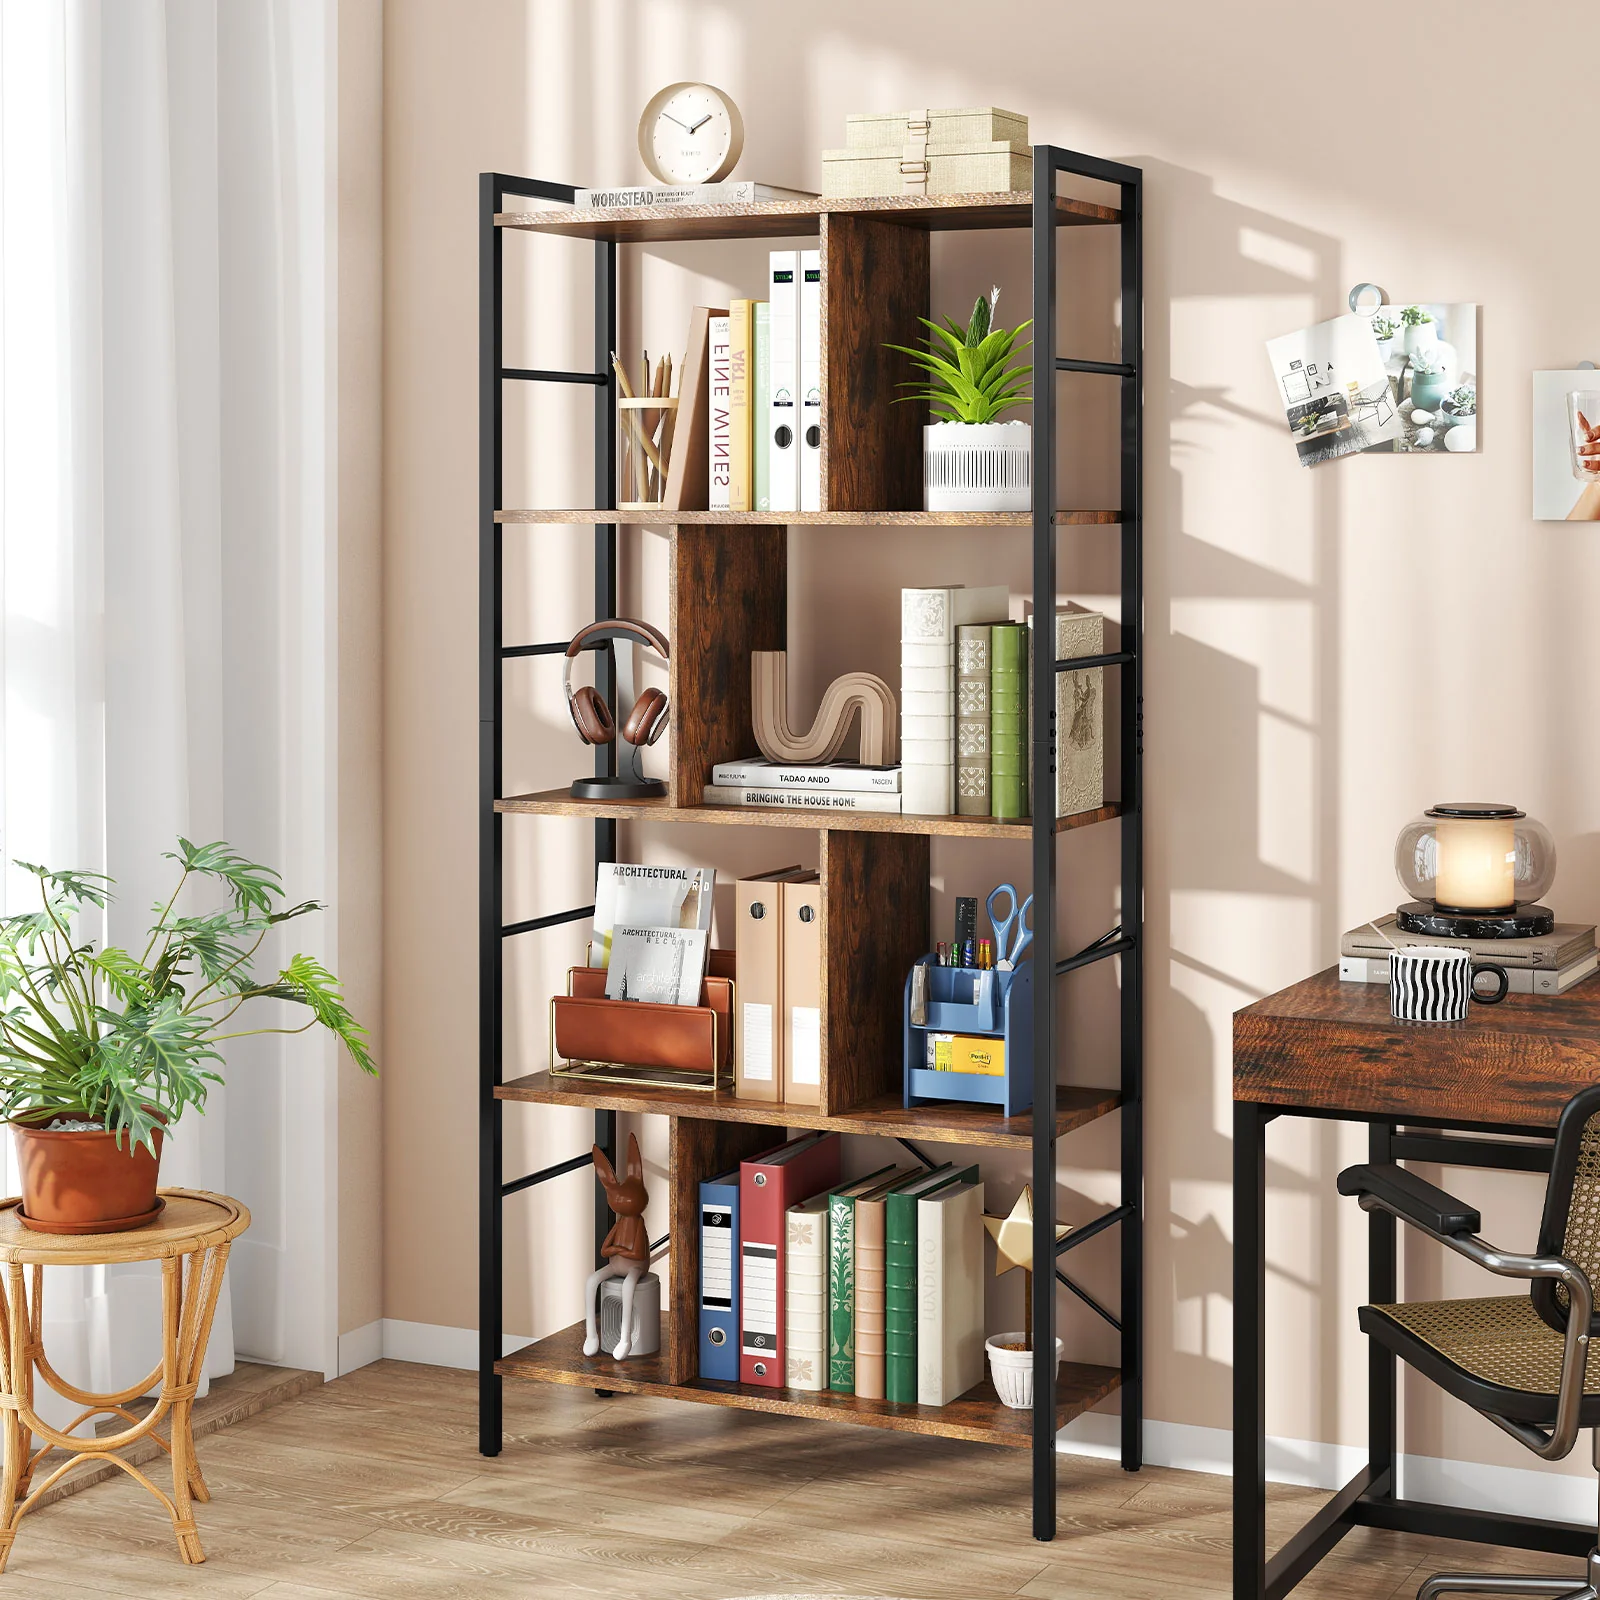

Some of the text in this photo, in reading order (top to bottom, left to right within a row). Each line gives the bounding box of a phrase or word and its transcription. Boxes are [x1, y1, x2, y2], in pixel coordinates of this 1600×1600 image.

[590, 191, 654, 208] WORKSTEAD
[779, 774, 830, 784] TADAO ANDO
[746, 792, 856, 807] BRINGING THE HOUSE HOME
[612, 866, 688, 880] ARCHITECTURAL
[647, 879, 710, 892] REORD
[621, 928, 677, 939] ARCHITECTURAL
[646, 937, 693, 947] RECORD
